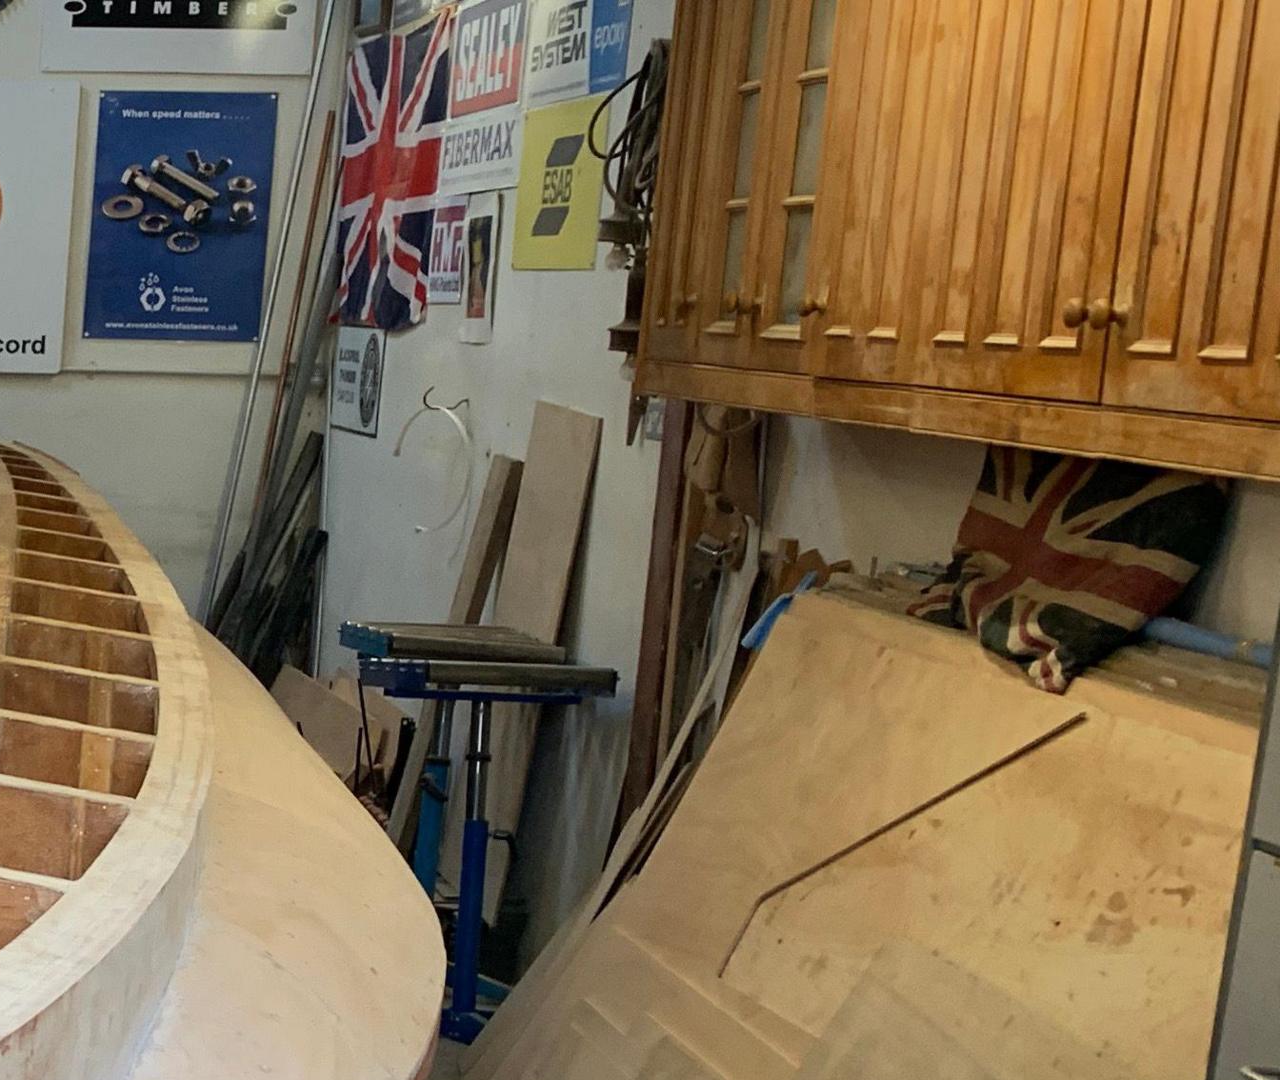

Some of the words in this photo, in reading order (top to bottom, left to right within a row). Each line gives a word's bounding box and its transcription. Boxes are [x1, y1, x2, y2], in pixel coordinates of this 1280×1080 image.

[102, 1, 258, 15] TIMBER
[547, 1, 587, 38] WEST
[456, 2, 521, 101] SEALEY
[531, 31, 586, 73] SYSTEM
[594, 22, 626, 56] epoxy
[122, 109, 149, 118] When
[152, 109, 182, 119] speed
[442, 120, 516, 170] FIBERMAX
[542, 169, 573, 205] ESAB
[173, 285, 194, 293] Avon
